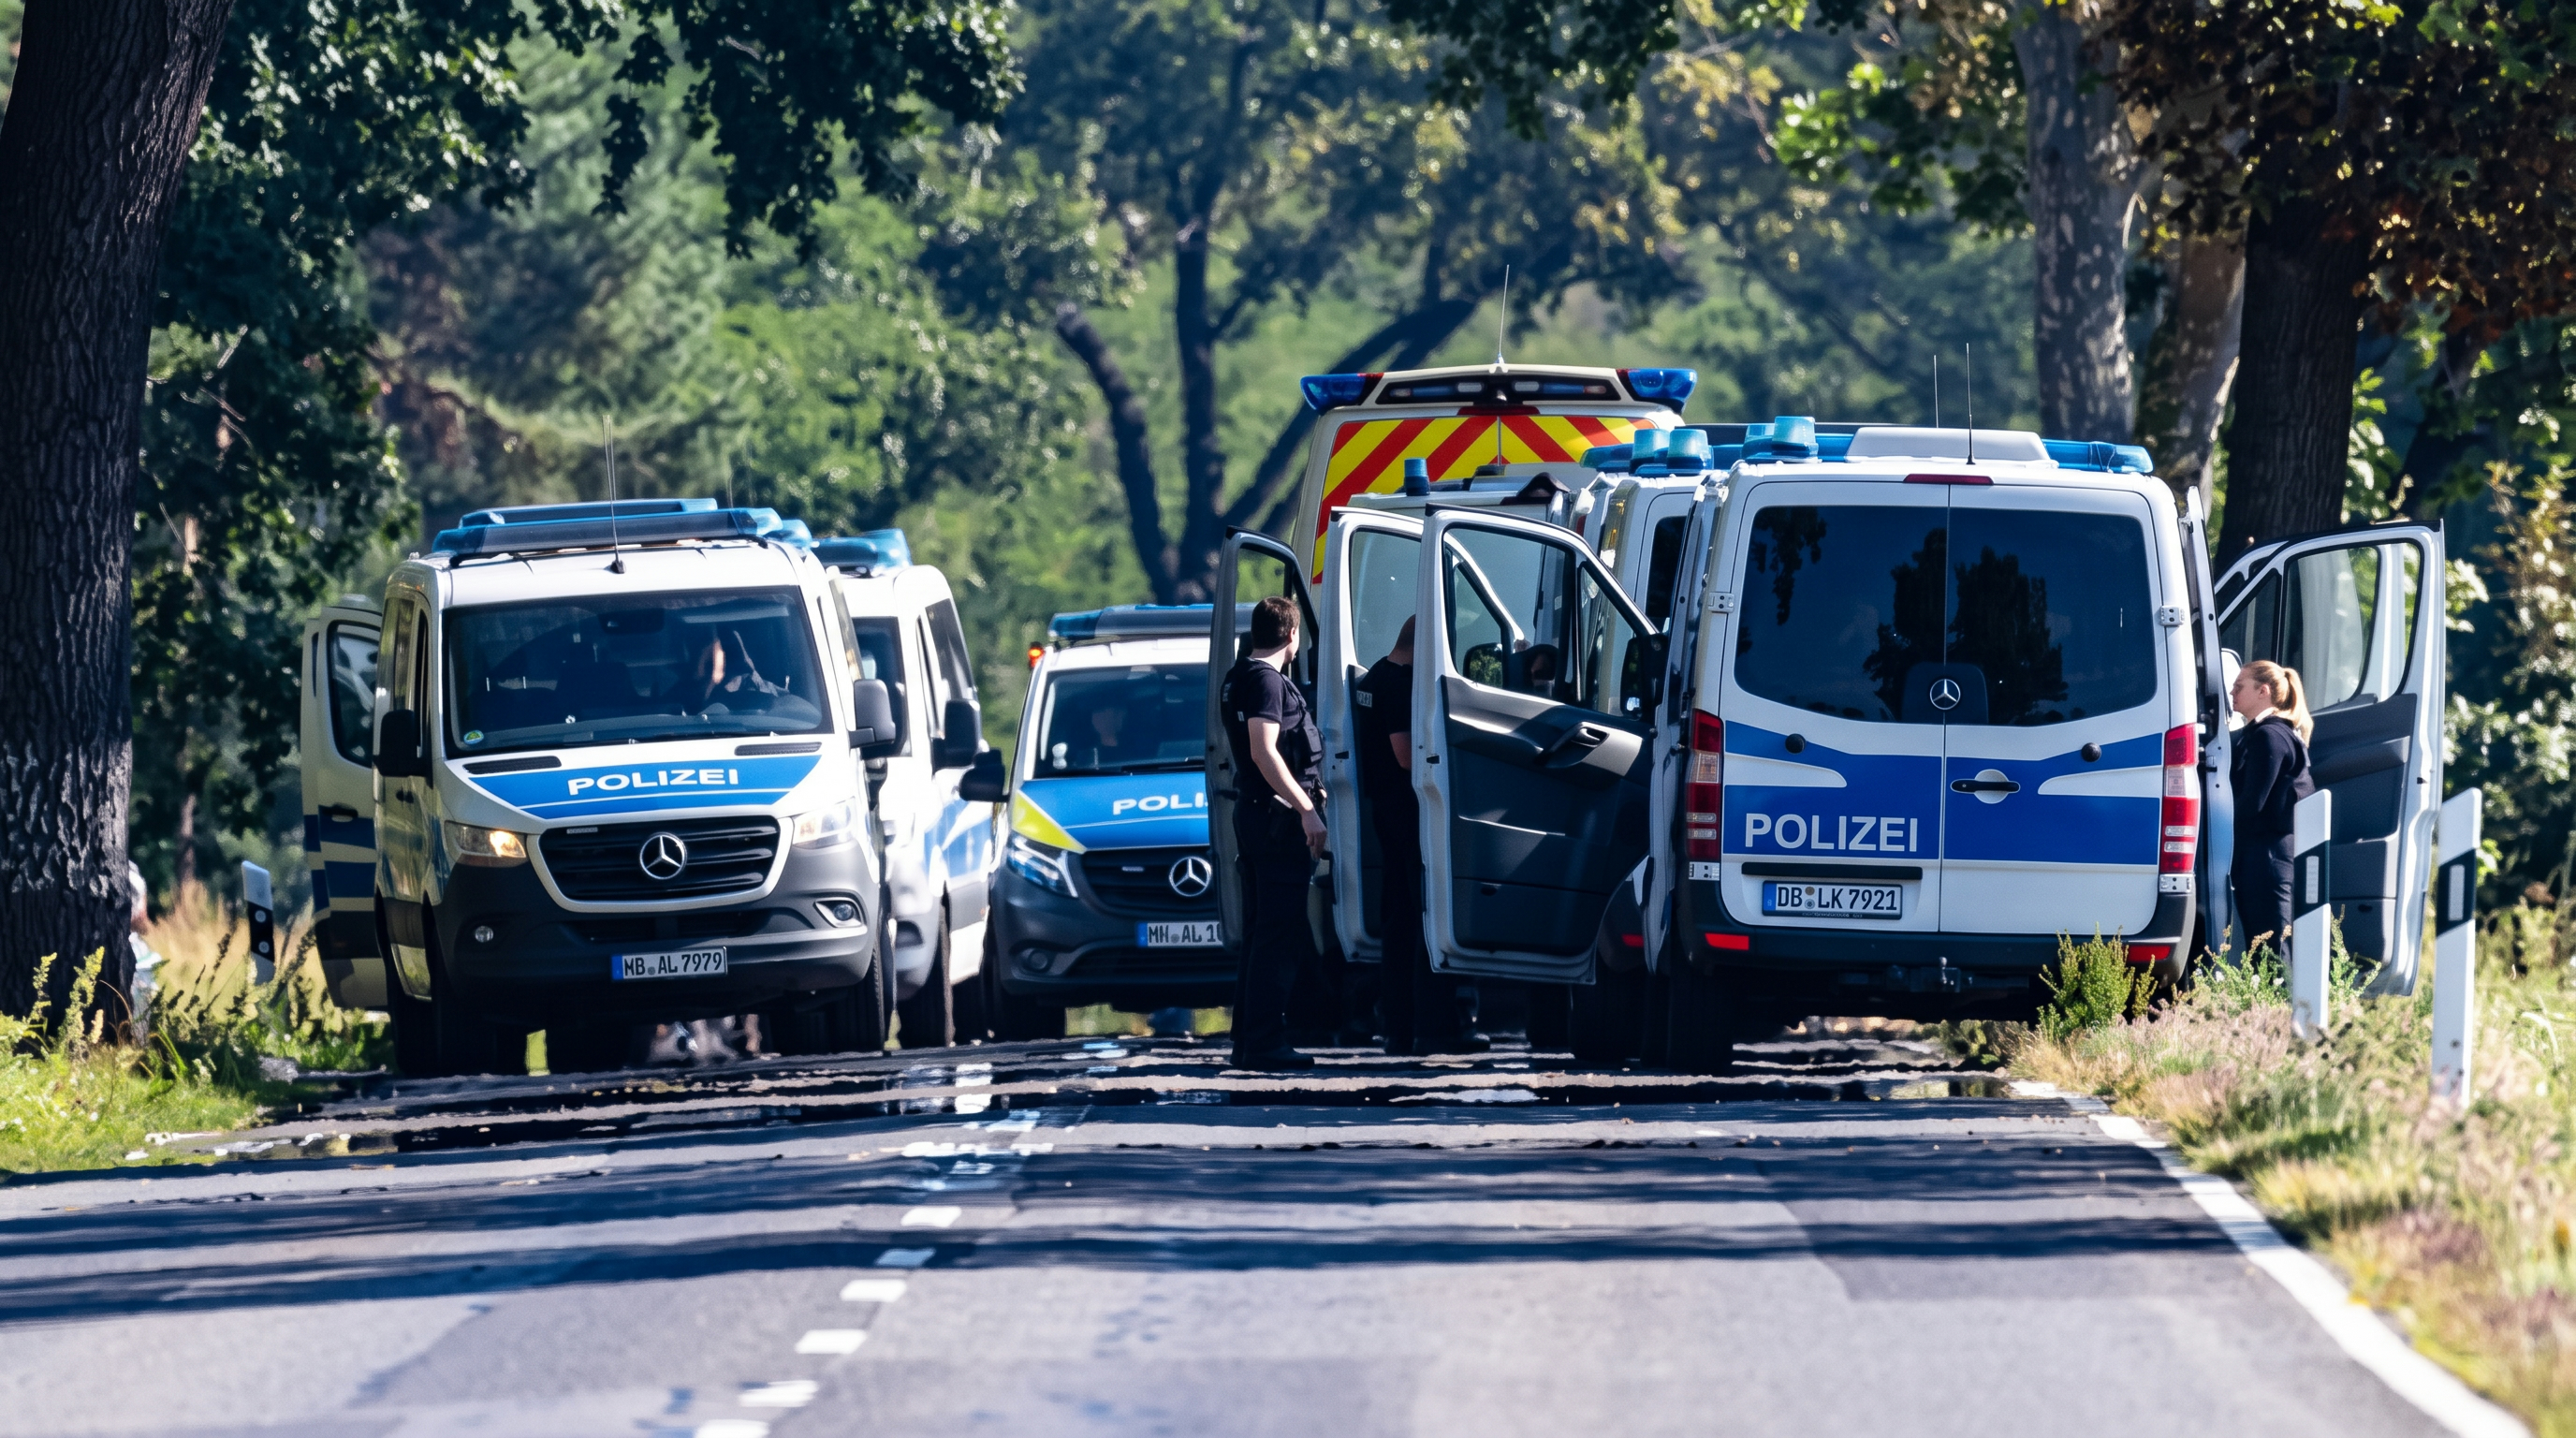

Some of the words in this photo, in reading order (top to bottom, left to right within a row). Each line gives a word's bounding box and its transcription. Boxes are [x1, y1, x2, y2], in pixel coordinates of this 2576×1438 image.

[567, 769, 739, 796] POLIZEI
[1112, 792, 1208, 815] POLI
[1745, 813, 1918, 852] POLIZEI
[1778, 887, 1803, 907] DB
[1818, 888, 1843, 909] LK
[1849, 888, 1897, 911] 7921
[1181, 924, 1202, 943] AL
[623, 957, 646, 976] MB
[657, 955, 678, 975] AL
[681, 952, 722, 973] 7979
